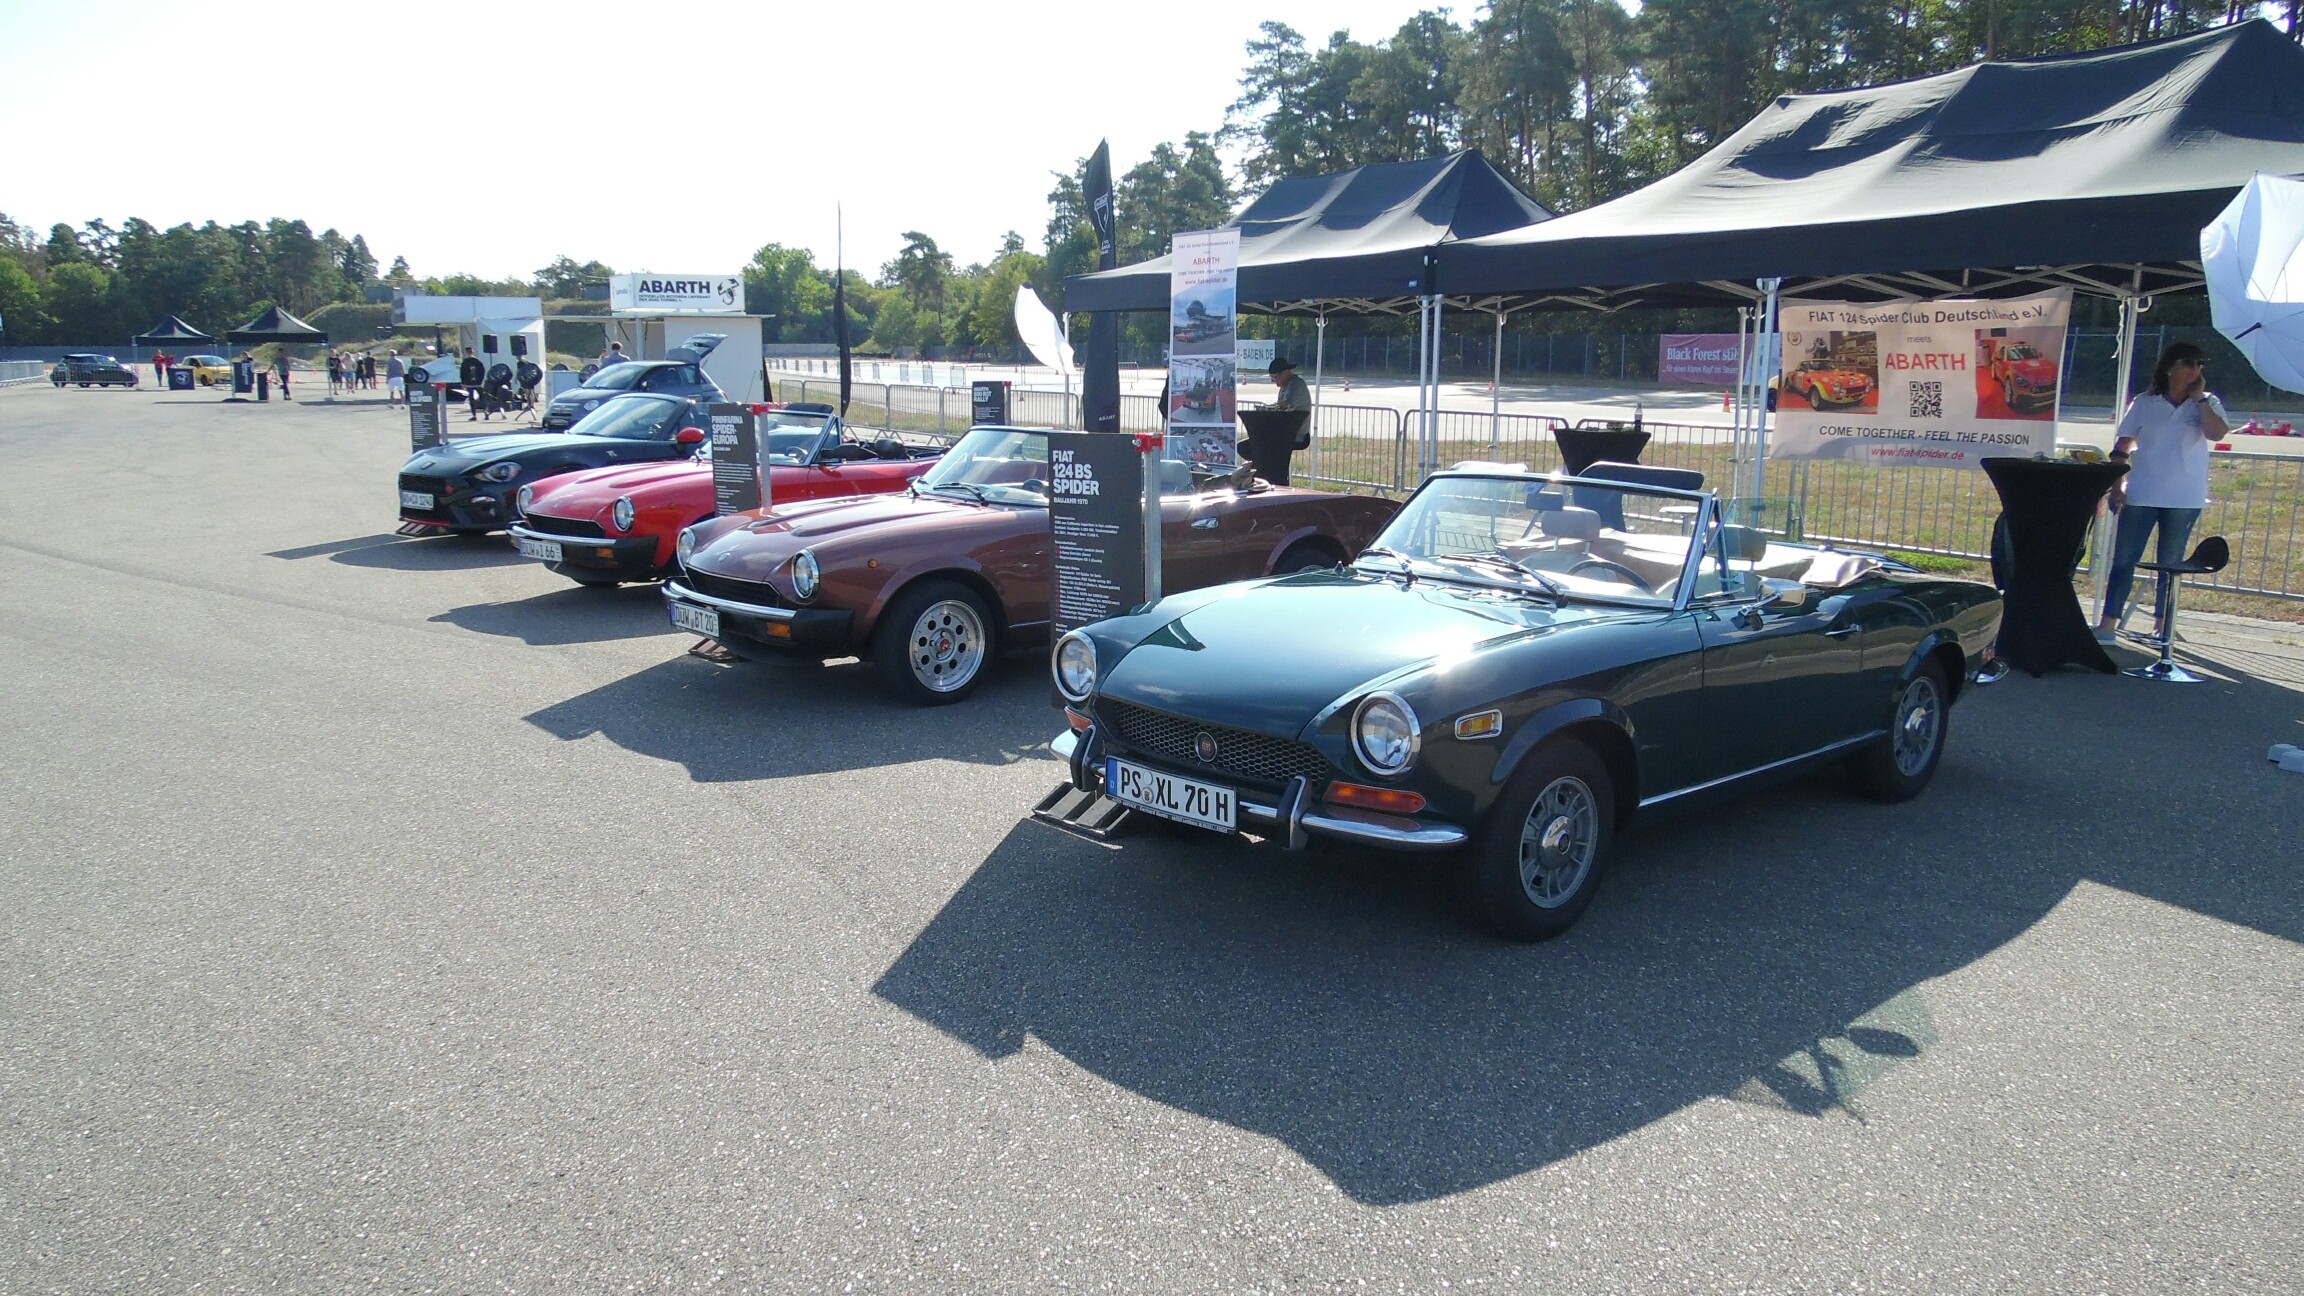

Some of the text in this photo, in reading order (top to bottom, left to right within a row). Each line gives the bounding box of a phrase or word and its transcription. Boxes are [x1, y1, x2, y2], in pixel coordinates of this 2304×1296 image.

[1192, 257, 1220, 266] ABARTH
[639, 280, 710, 293] ABARTH
[1809, 305, 2047, 325] FIAT 124 Spider Club Deutschland e.V.
[1906, 335, 1932, 343] meets
[1666, 347, 1691, 361] Black
[1693, 347, 1720, 361] Forest
[1885, 352, 1966, 371] ABARTH
[712, 424, 737, 435] SPIDER-
[1819, 425, 1853, 437] COME
[1857, 427, 1915, 440] TOGETHER
[1924, 430, 1952, 442] FEEL
[1956, 432, 1978, 443] THE
[1980, 433, 2030, 446] PASSION
[713, 434, 739, 445] EUROPA
[1053, 450, 1074, 462] FIAT
[1871, 447, 1965, 460] www.fiat-spider.de
[1053, 463, 1093, 479] 124 BS
[1053, 478, 1100, 496] SPIDER
[1053, 496, 1077, 504] BAUJAHR
[705, 613, 714, 633] 20
[1120, 766, 1141, 799] PS
[1155, 776, 1178, 810] XL
[1184, 783, 1209, 817] 70
[1215, 791, 1228, 823] H
